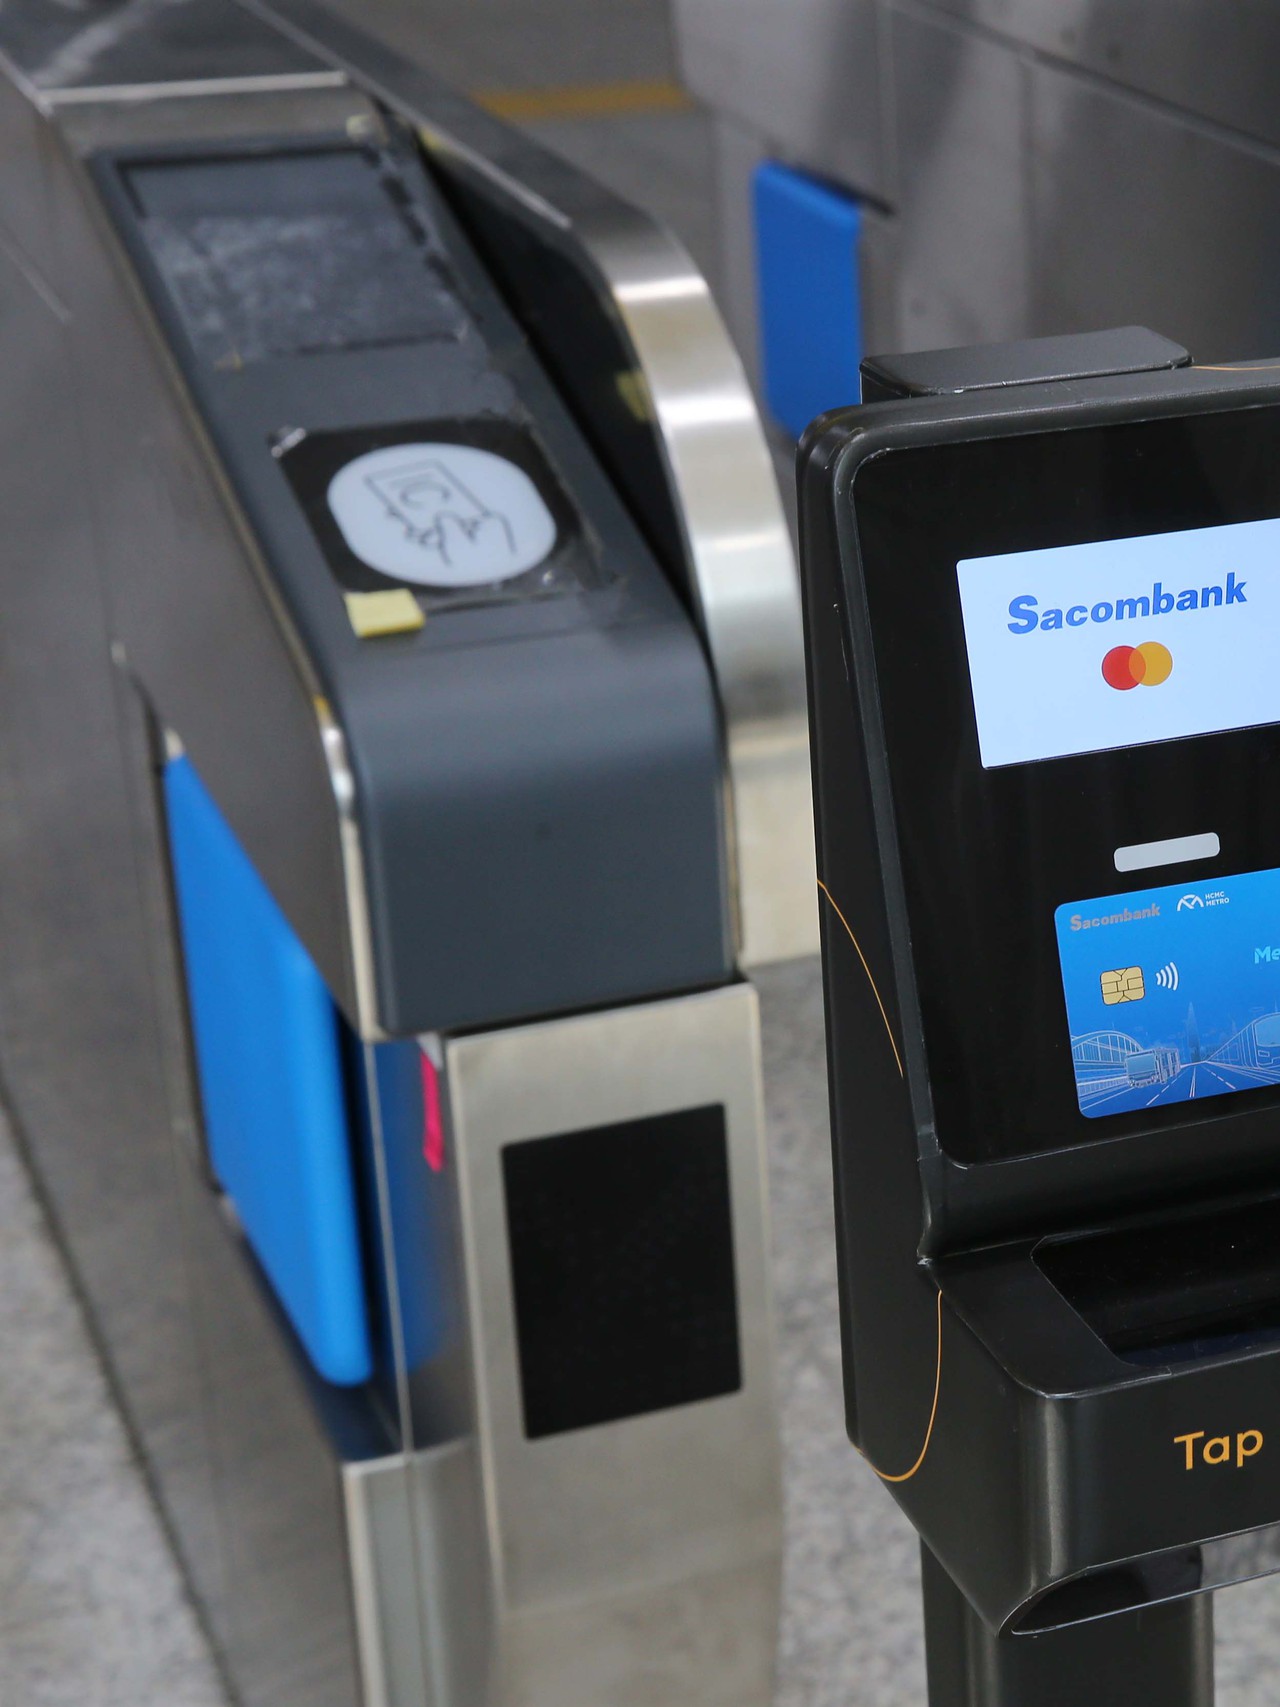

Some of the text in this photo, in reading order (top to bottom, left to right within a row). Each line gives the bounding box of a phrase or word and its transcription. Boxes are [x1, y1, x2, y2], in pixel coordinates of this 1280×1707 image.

[1007, 572, 1248, 635] Sacombank
[1069, 903, 1161, 932] Sacombank
[1206, 897, 1230, 907] METRO
[1173, 1430, 1264, 1470] Tap
